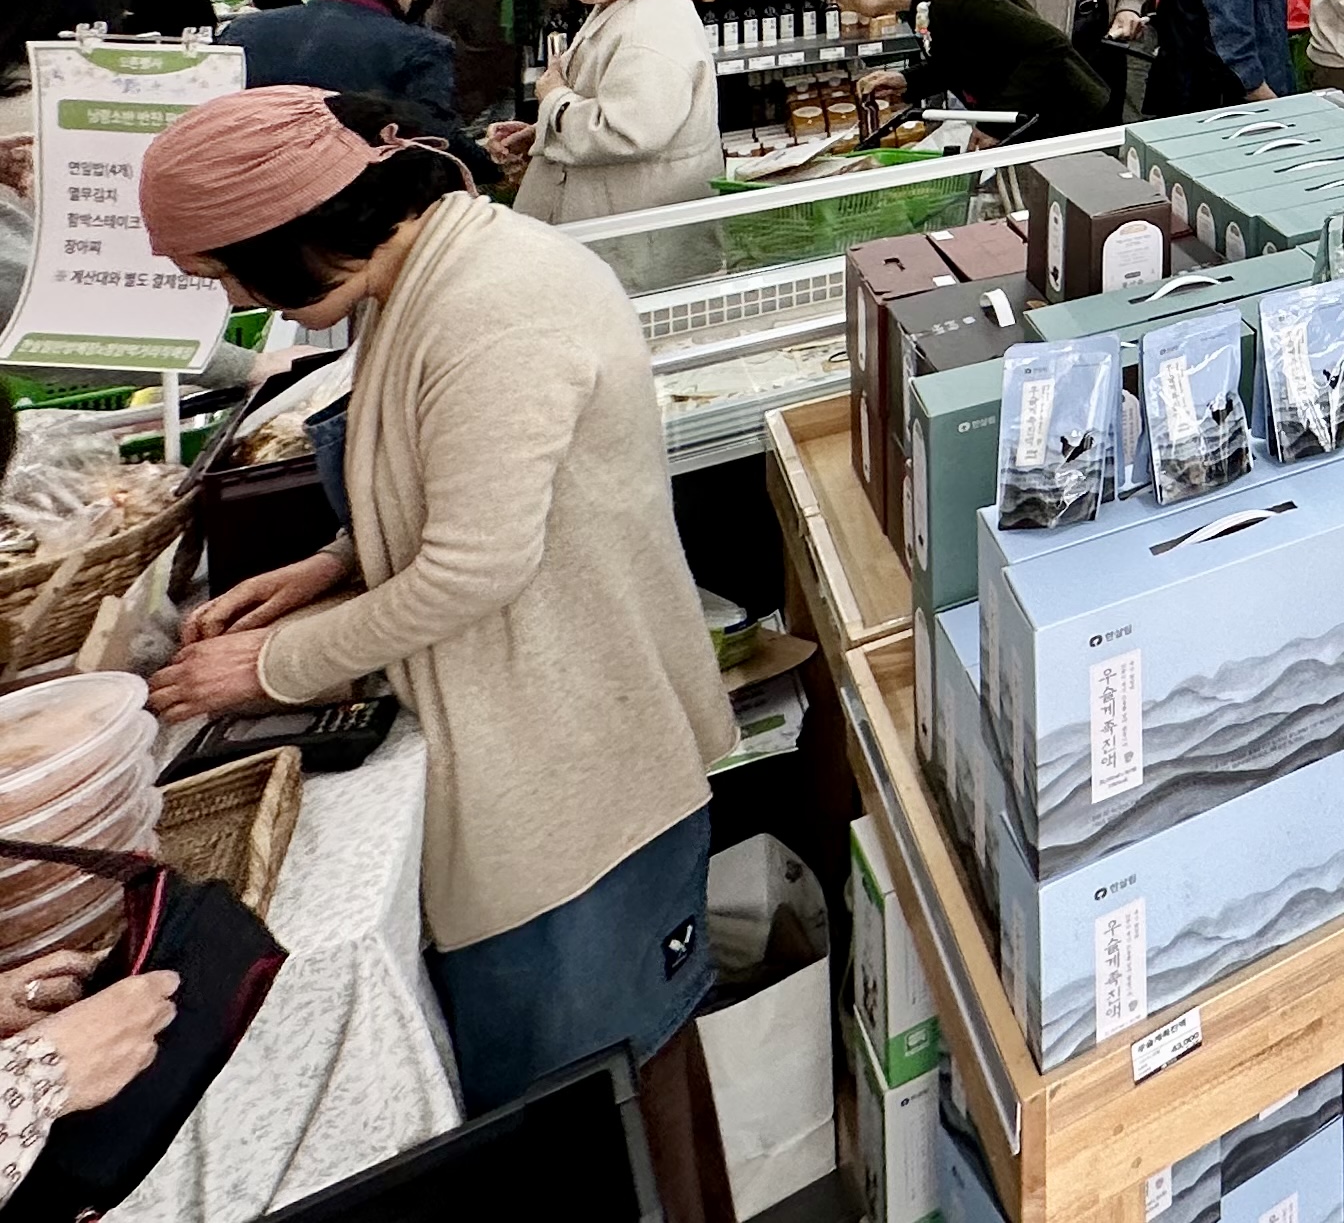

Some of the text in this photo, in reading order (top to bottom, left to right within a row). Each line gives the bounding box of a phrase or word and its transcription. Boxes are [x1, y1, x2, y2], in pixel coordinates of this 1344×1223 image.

[68, 186, 118, 203] 열무김치
[124, 272, 148, 288] 별도
[1105, 624, 1133, 643] 한살림
[1109, 874, 1137, 894] 한살림
